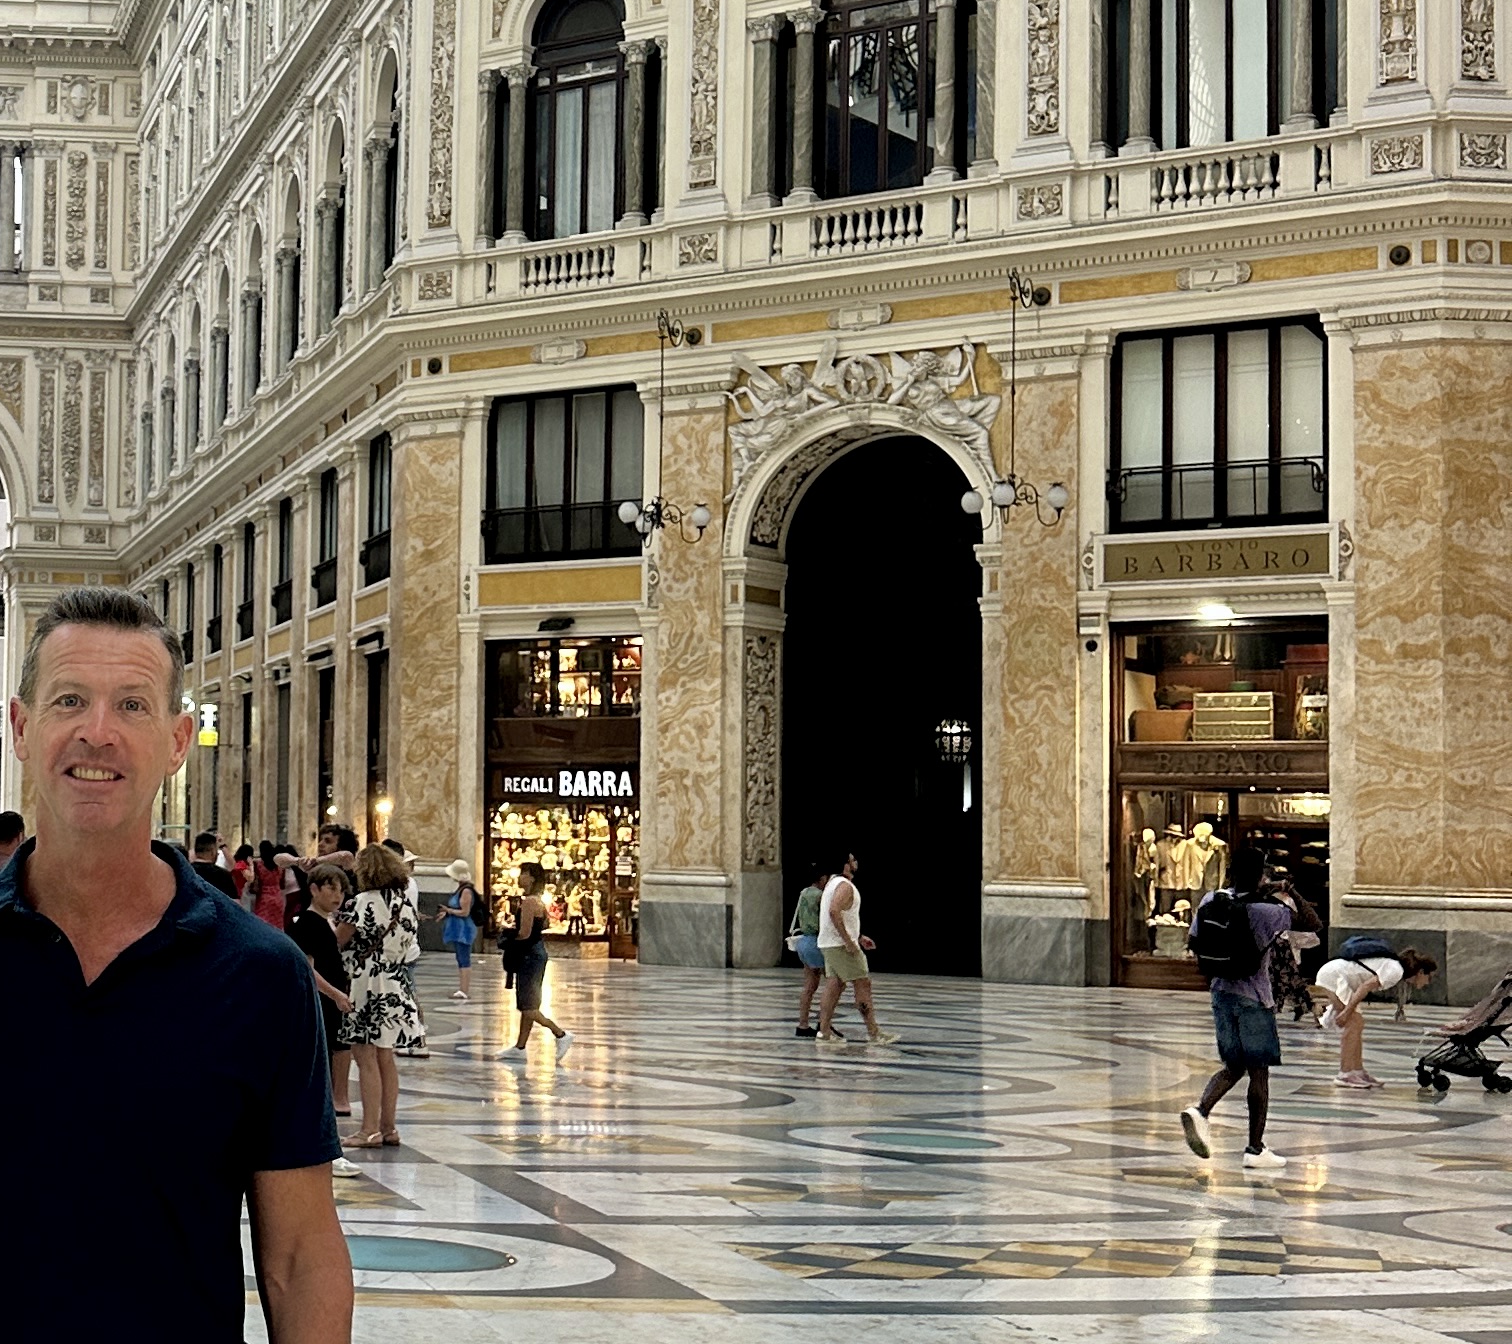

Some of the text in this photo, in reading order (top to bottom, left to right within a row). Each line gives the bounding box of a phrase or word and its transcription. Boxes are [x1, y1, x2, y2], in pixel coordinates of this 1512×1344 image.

[1209, 269, 1219, 282] 7
[1172, 539, 1259, 554] ANTONIO
[1123, 547, 1310, 575] BARBARO
[1155, 751, 1289, 773] BARBARO
[504, 770, 634, 797] REGALI BARRA
